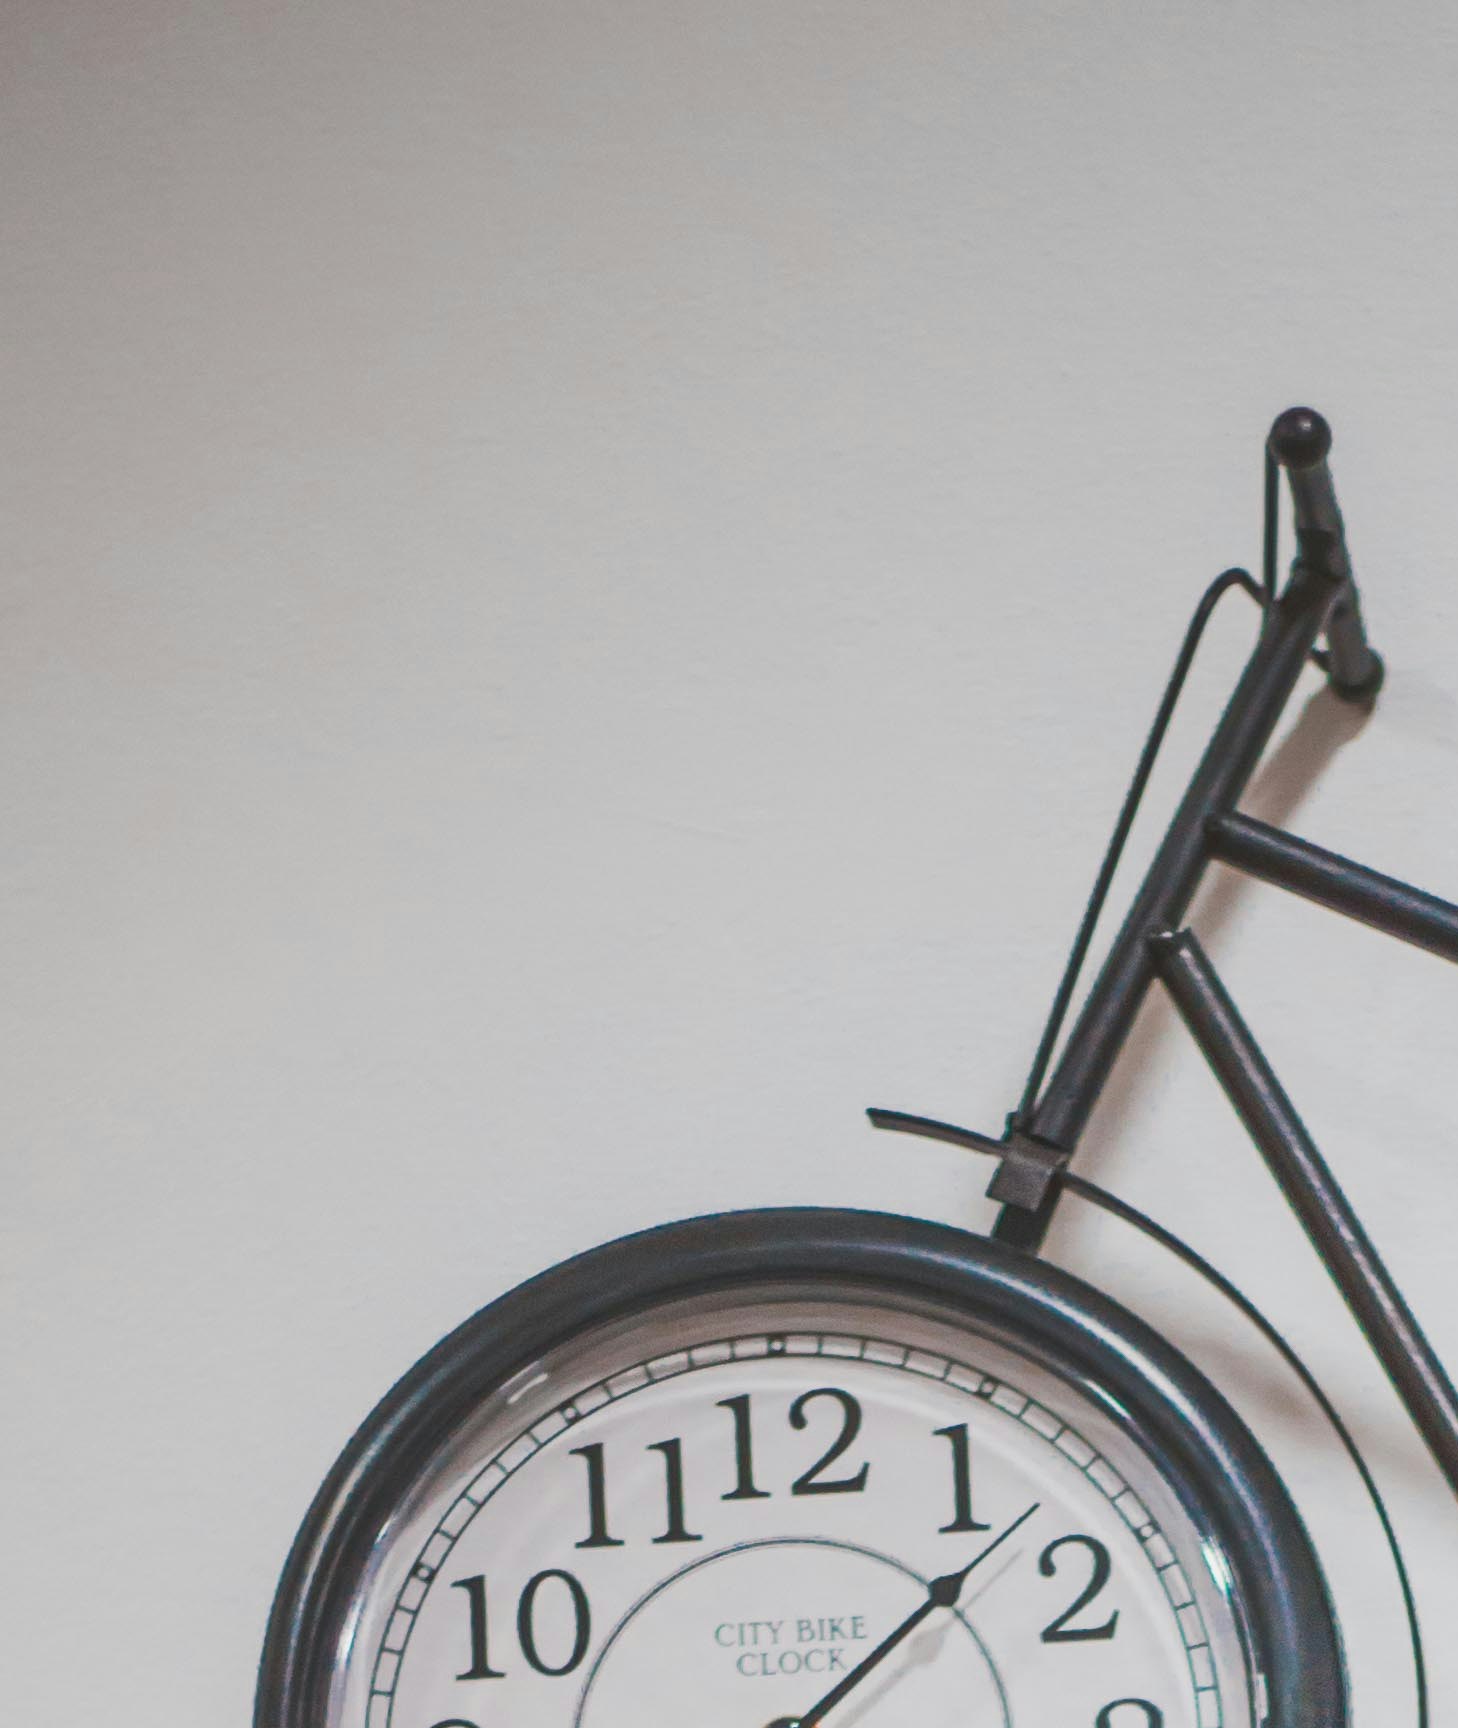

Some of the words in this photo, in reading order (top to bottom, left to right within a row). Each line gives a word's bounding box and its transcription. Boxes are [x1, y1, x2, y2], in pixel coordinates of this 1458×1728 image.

[570, 1438, 702, 1548] 11
[714, 1388, 870, 1502] 12
[933, 1423, 991, 1534] 1
[451, 1569, 591, 1681] 10
[714, 1620, 783, 1648] CITY
[796, 1616, 868, 1642] BIKE
[1038, 1534, 1120, 1644] 2
[736, 1649, 846, 1676] CLOCK
